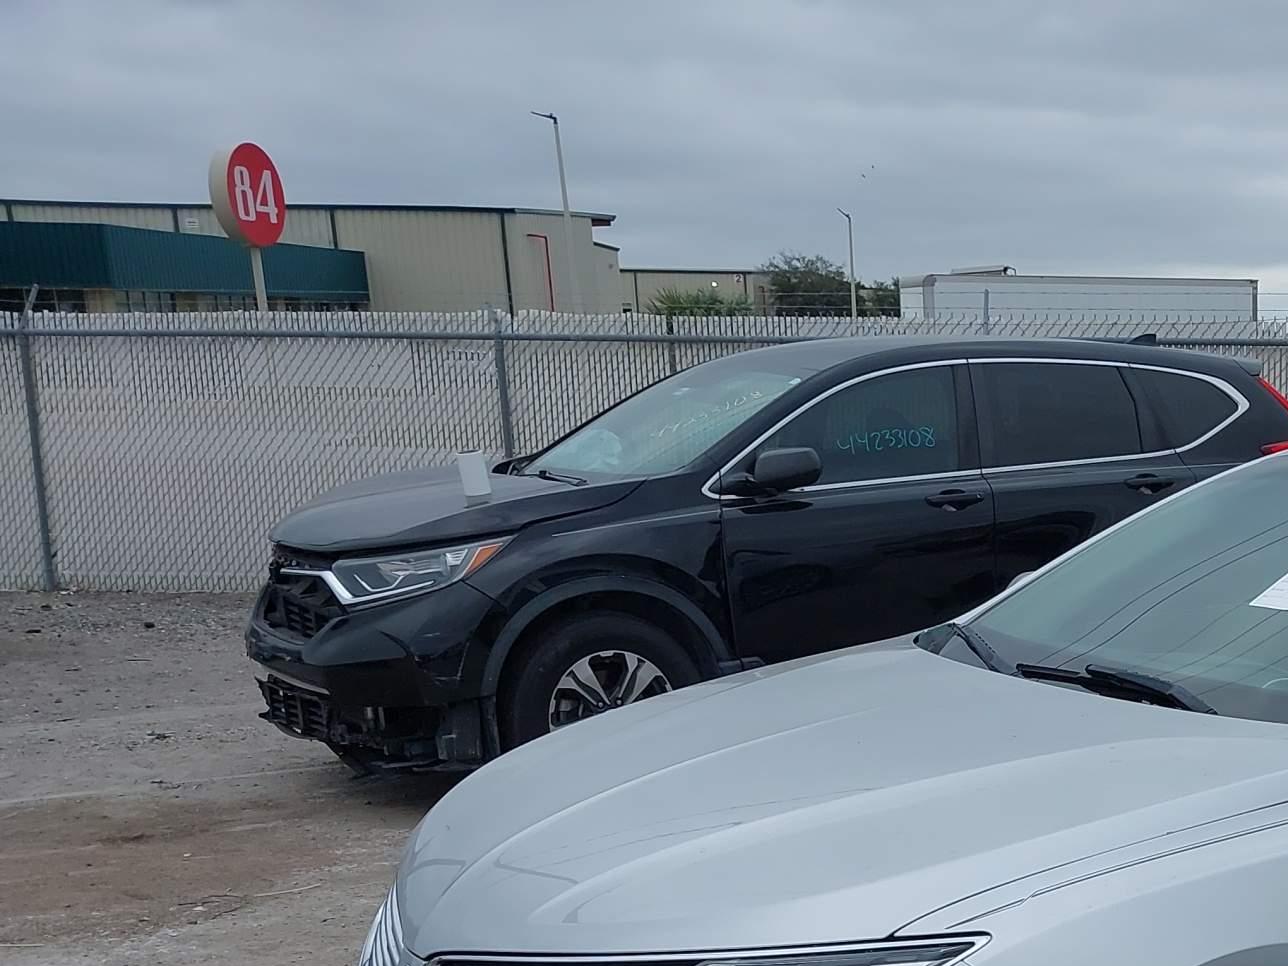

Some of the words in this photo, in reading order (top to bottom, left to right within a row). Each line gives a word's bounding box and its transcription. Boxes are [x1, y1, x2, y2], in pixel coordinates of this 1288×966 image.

[234, 165, 278, 224] 84
[735, 274, 742, 283] 2
[836, 426, 936, 455] 44233108
